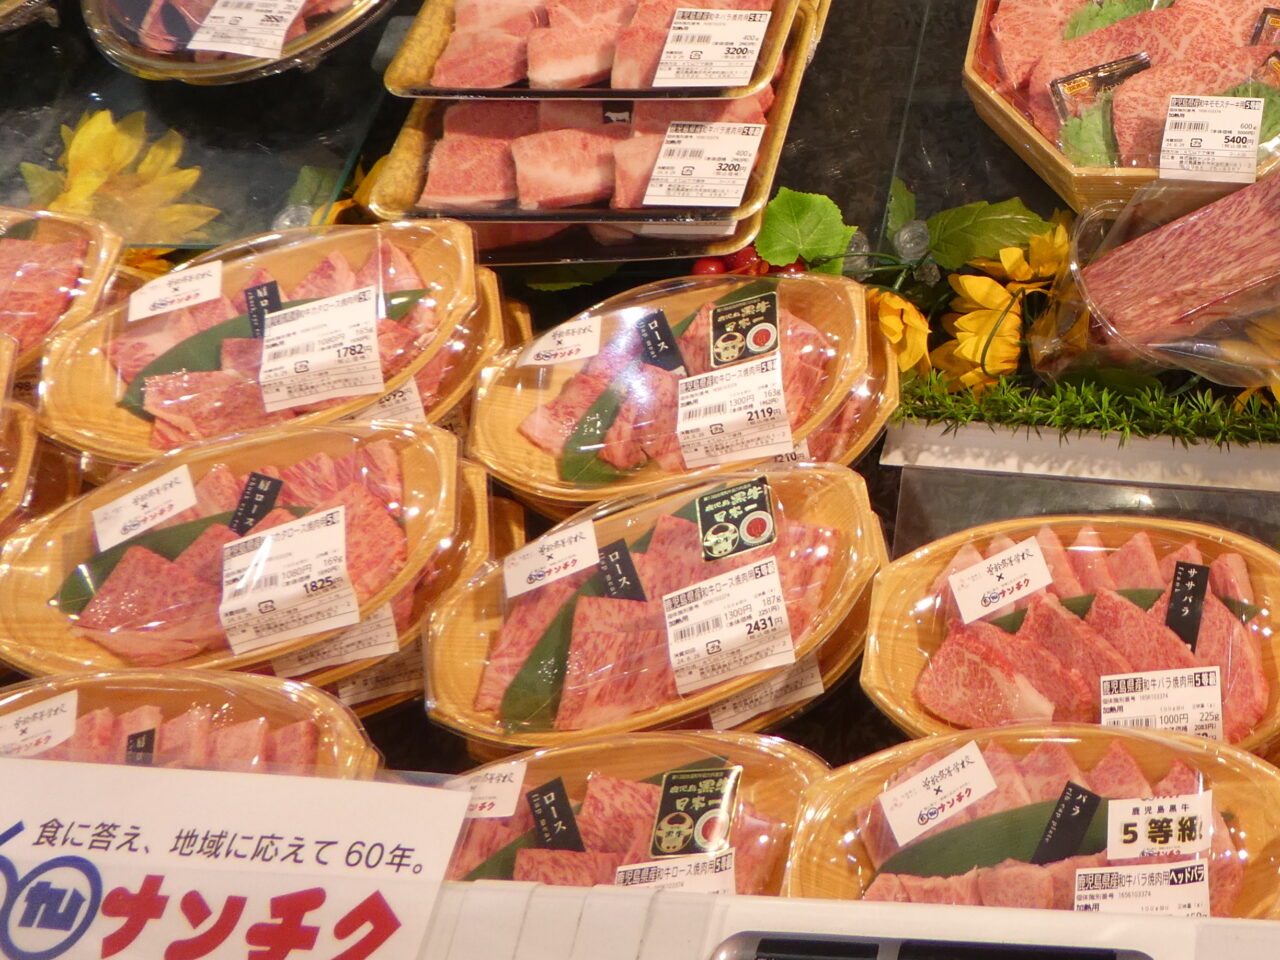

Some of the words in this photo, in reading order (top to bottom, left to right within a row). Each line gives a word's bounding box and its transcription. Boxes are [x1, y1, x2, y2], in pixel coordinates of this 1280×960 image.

[648, 319, 671, 353] ロース
[746, 406, 782, 423] 2119円
[608, 551, 632, 588] ロース
[999, 577, 1032, 598] ナンチク
[1180, 566, 1199, 618] ササバラ
[745, 616, 784, 635] 2431円
[1159, 713, 1189, 725] 1000円
[1199, 711, 1221, 723] 225g
[543, 791, 568, 834] ロース
[936, 786, 974, 816] ナンチク
[1071, 792, 1089, 817] バラ
[1131, 802, 1191, 816] 鹿児島黒牛
[99, 873, 403, 960] ナンチク
